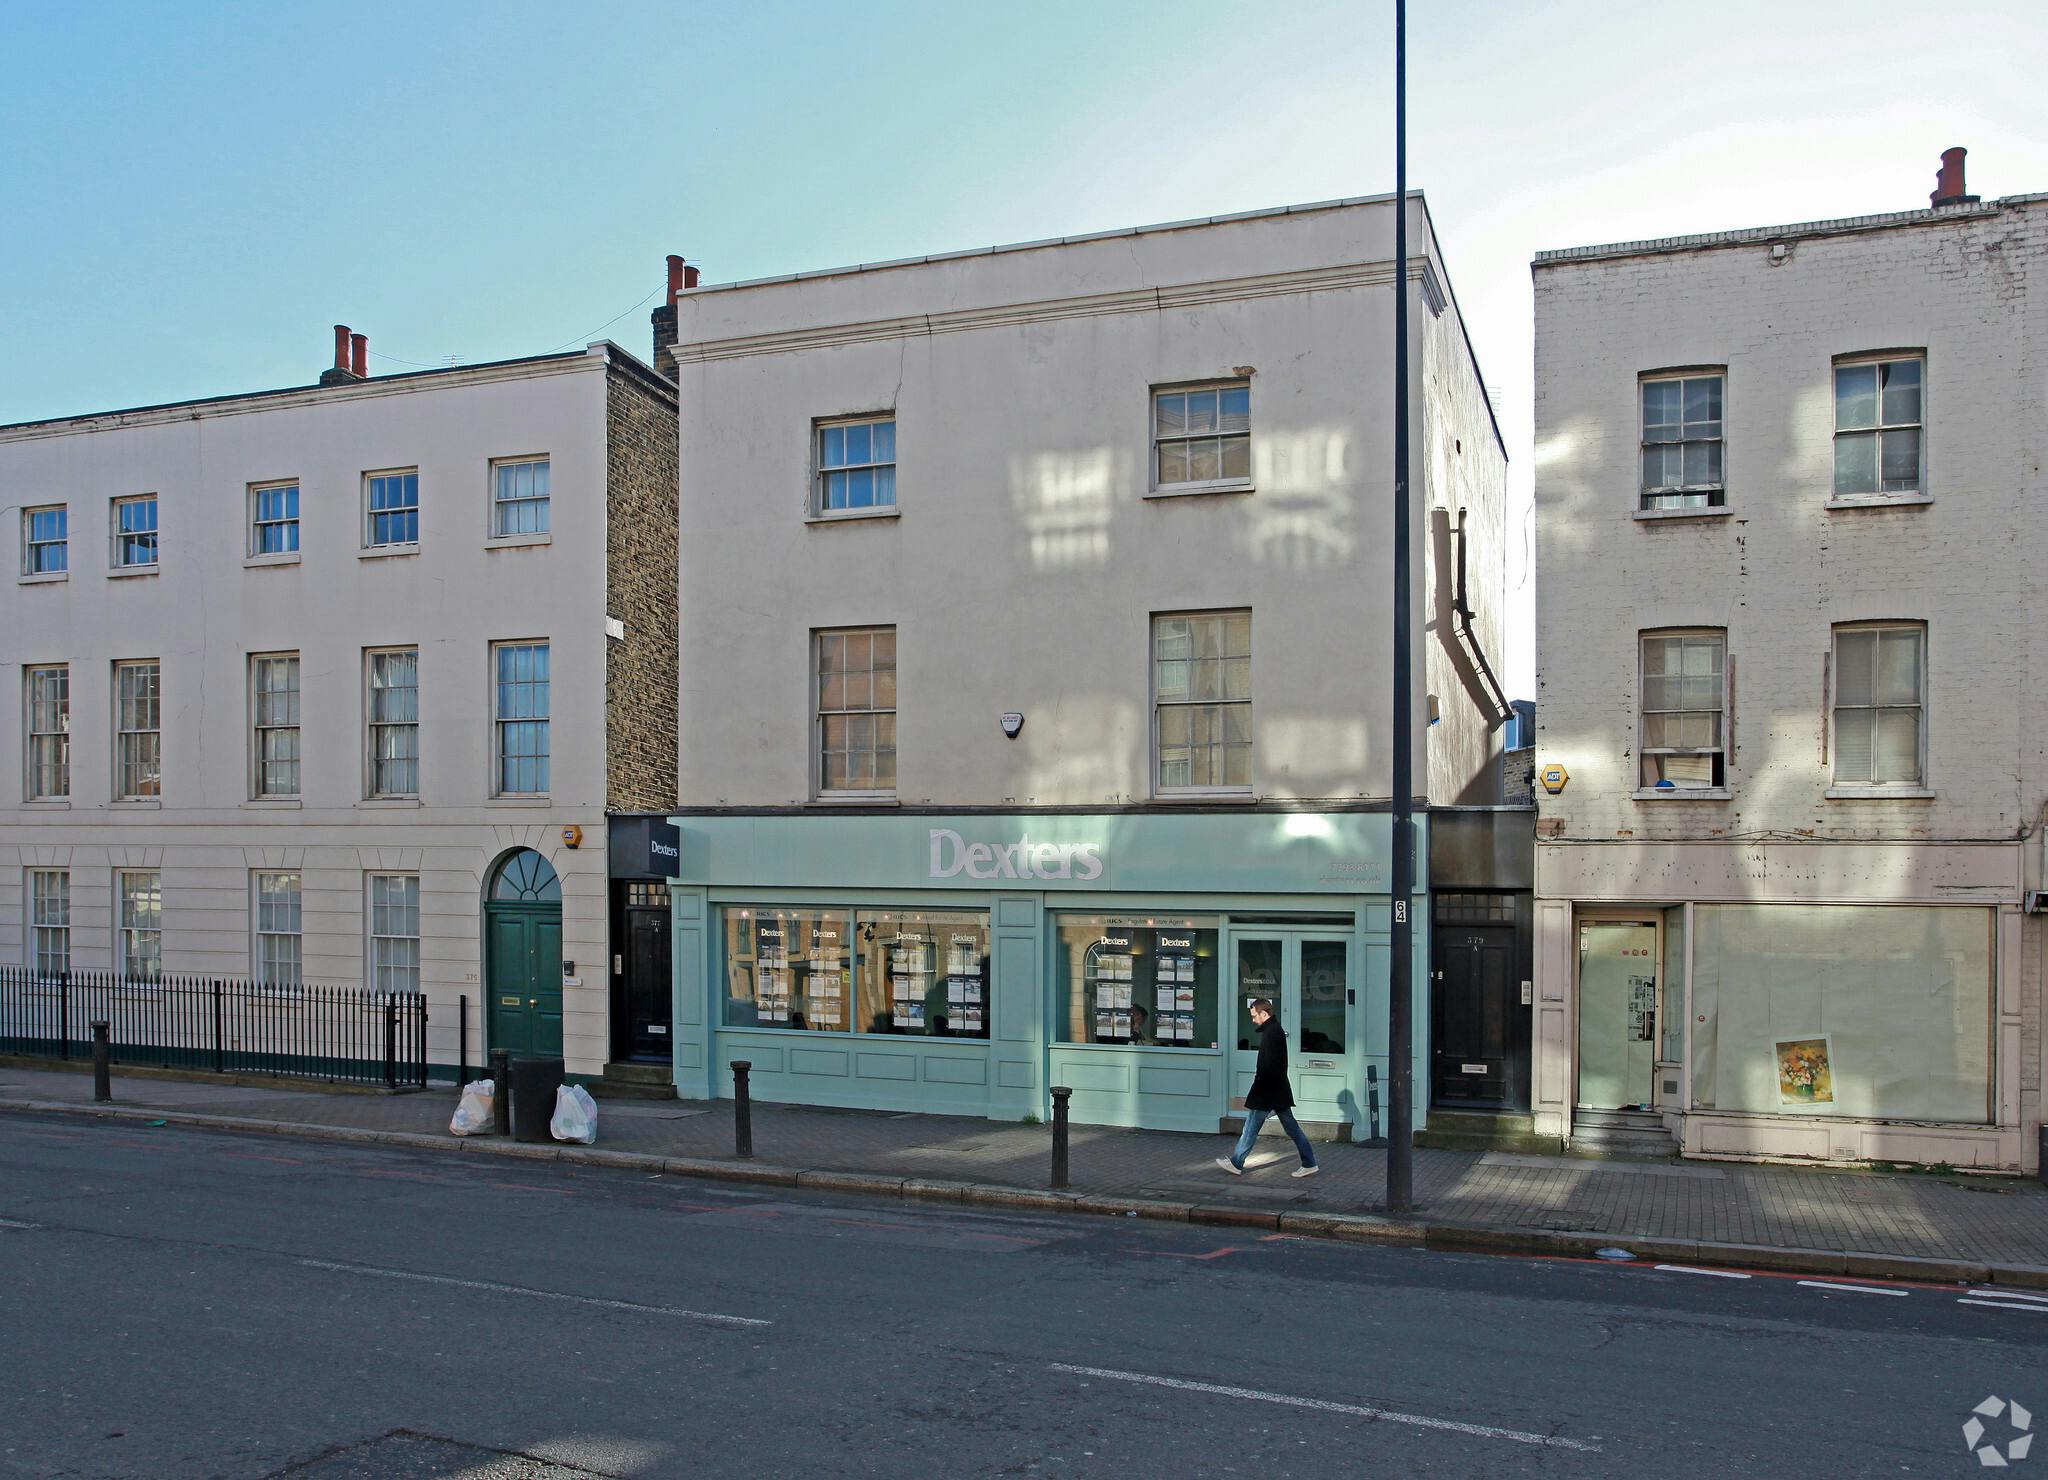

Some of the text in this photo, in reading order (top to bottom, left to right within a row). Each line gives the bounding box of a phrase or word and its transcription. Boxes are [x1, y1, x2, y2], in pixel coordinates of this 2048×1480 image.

[651, 841, 678, 857] Dexters
[928, 829, 1103, 880] Dexters
[761, 928, 785, 937] Dexters
[812, 929, 837, 938] Dexters
[896, 931, 921, 940] Dexters
[951, 933, 977, 942] Dexters
[1101, 936, 1128, 946] Dexters
[1161, 937, 1190, 947] Dexters
